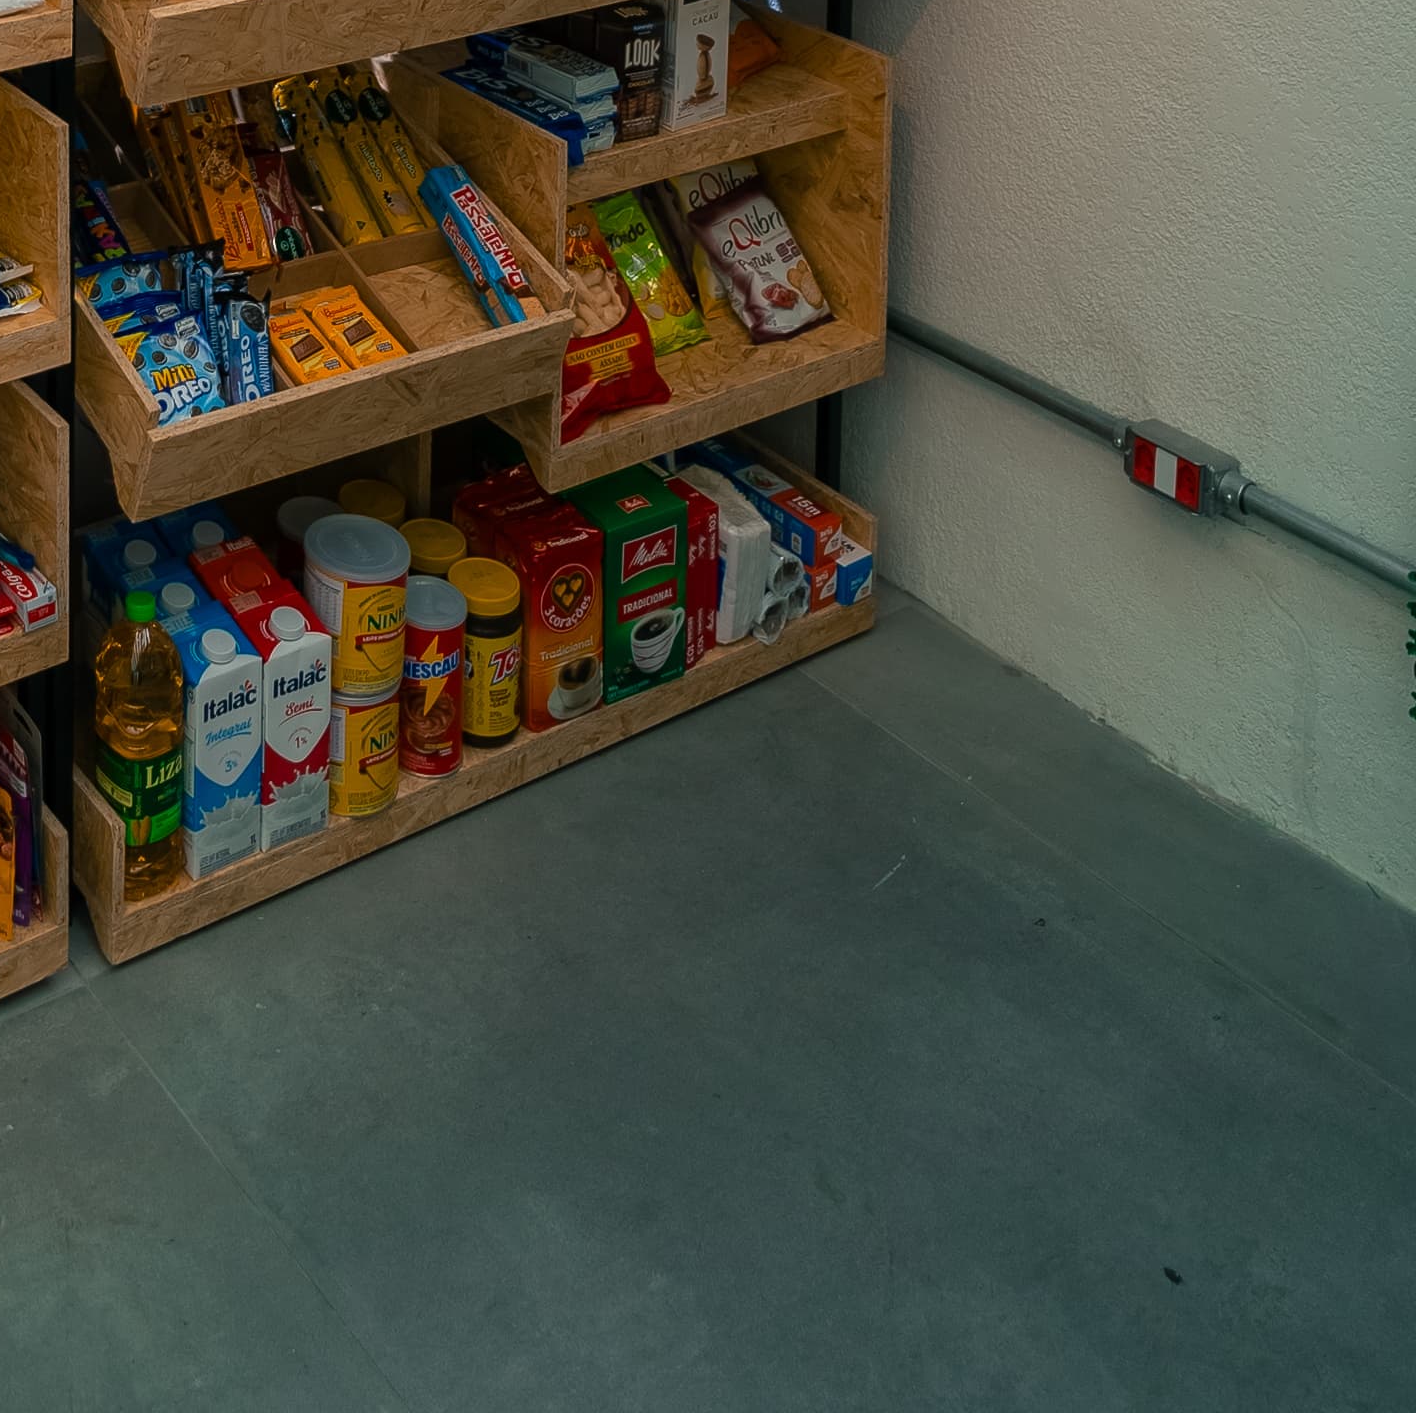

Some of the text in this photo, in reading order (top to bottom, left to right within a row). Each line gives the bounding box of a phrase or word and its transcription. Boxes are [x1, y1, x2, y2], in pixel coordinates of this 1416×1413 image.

[692, 11, 719, 27] CACAU
[624, 38, 661, 68] LOOK
[722, 205, 784, 259] eQlibri
[242, 335, 261, 402] OREO
[257, 332, 271, 391] WANDINHA
[155, 378, 211, 420] OREO
[790, 495, 822, 516] 15m
[630, 539, 669, 569] Melitta
[623, 587, 673, 614] TRADICIONAL
[402, 649, 460, 680] NESCAU
[538, 638, 594, 662] Tradicional
[273, 664, 327, 699] Italac
[202, 688, 257, 723] Italac
[285, 695, 315, 717] Semi
[205, 717, 253, 746] Integral
